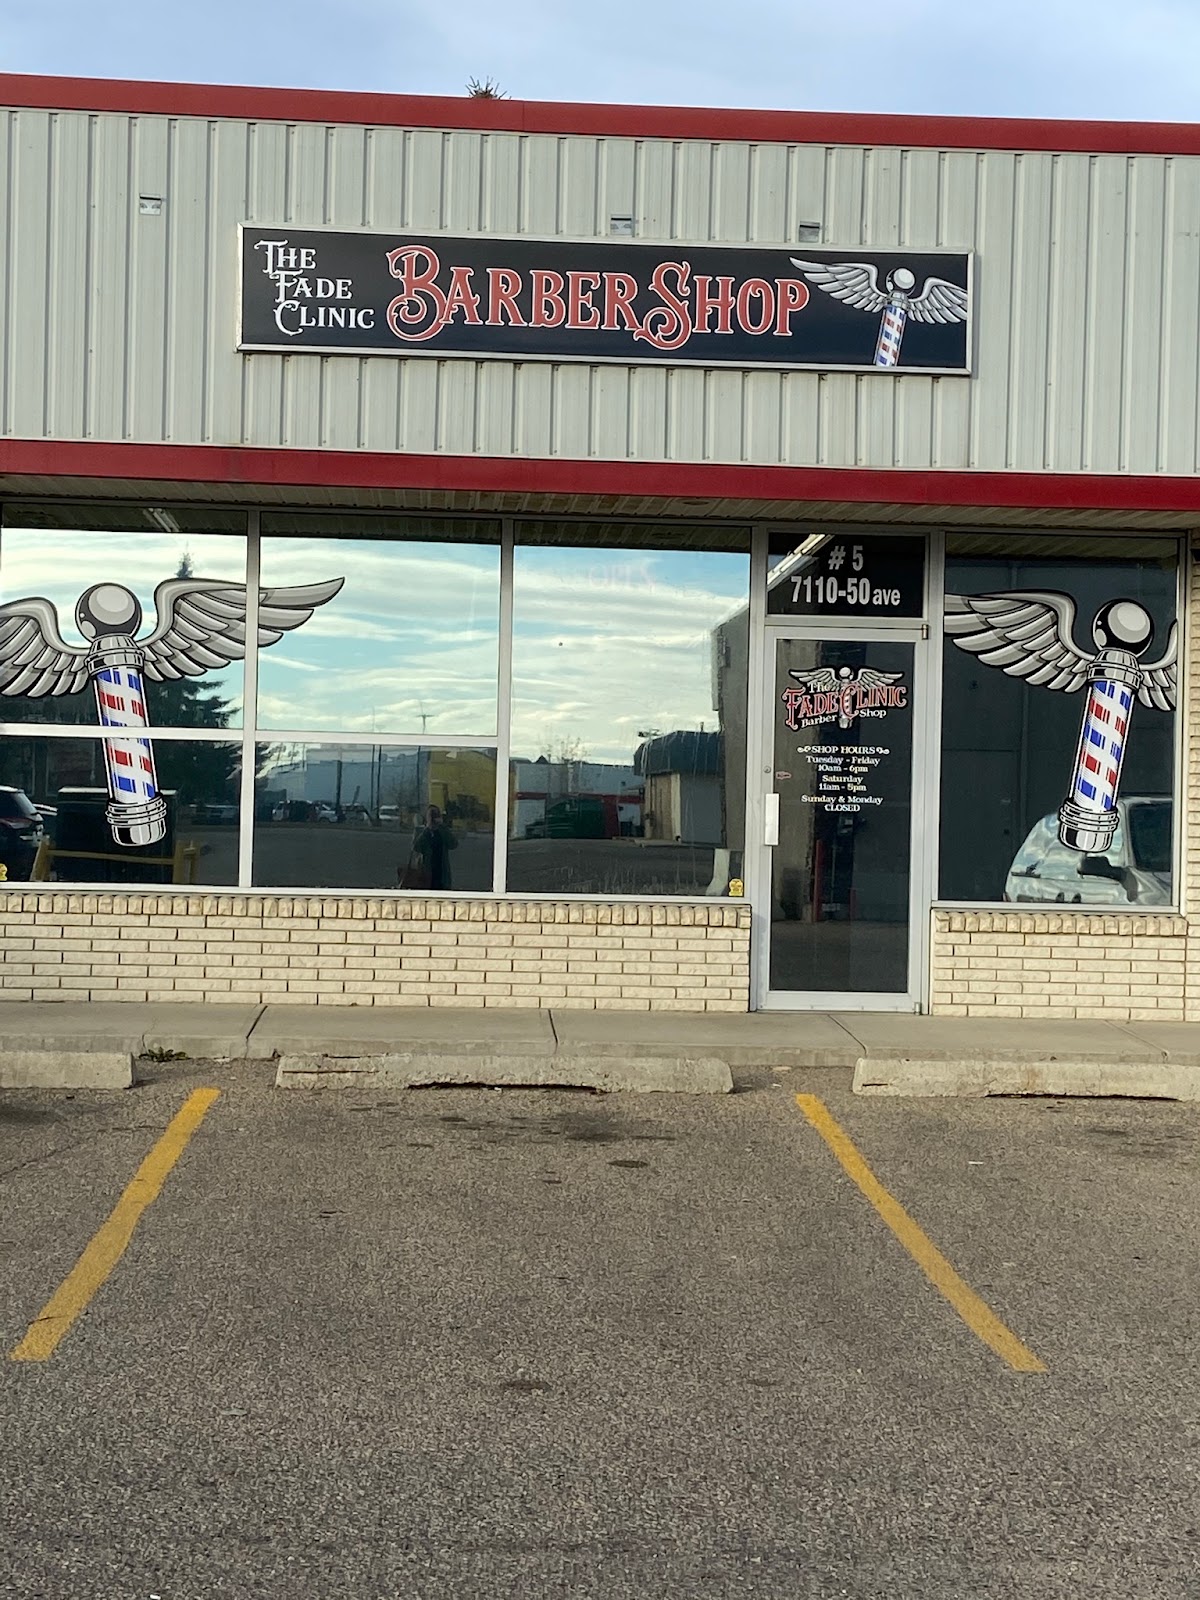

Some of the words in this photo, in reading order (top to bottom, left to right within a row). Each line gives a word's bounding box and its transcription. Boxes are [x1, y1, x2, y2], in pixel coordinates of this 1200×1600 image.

[254, 239, 316, 273] THE
[269, 269, 352, 302] FADE
[273, 300, 374, 336] CLINIC
[828, 545, 846, 570] #
[852, 545, 864, 571] 5
[790, 575, 870, 605] 7110-50
[872, 588, 901, 606] ave
[807, 682, 831, 693] The
[782, 687, 839, 731] FADE
[840, 684, 907, 719] CLINIC
[800, 714, 838, 728] Barber
[859, 708, 887, 718] Shop
[812, 745, 839, 754] SHOP
[841, 746, 875, 754] HOURS
[805, 755, 844, 766] Tuesday
[851, 756, 880, 767] Friday
[818, 764, 842, 772] 10am
[849, 765, 868, 774] 6pm
[822, 775, 864, 785] Saturday
[819, 783, 840, 791] 11am
[847, 783, 867, 792] 5pm
[801, 795, 837, 805] Sunday
[847, 796, 883, 805] Monday
[824, 804, 861, 812] CLOSED
